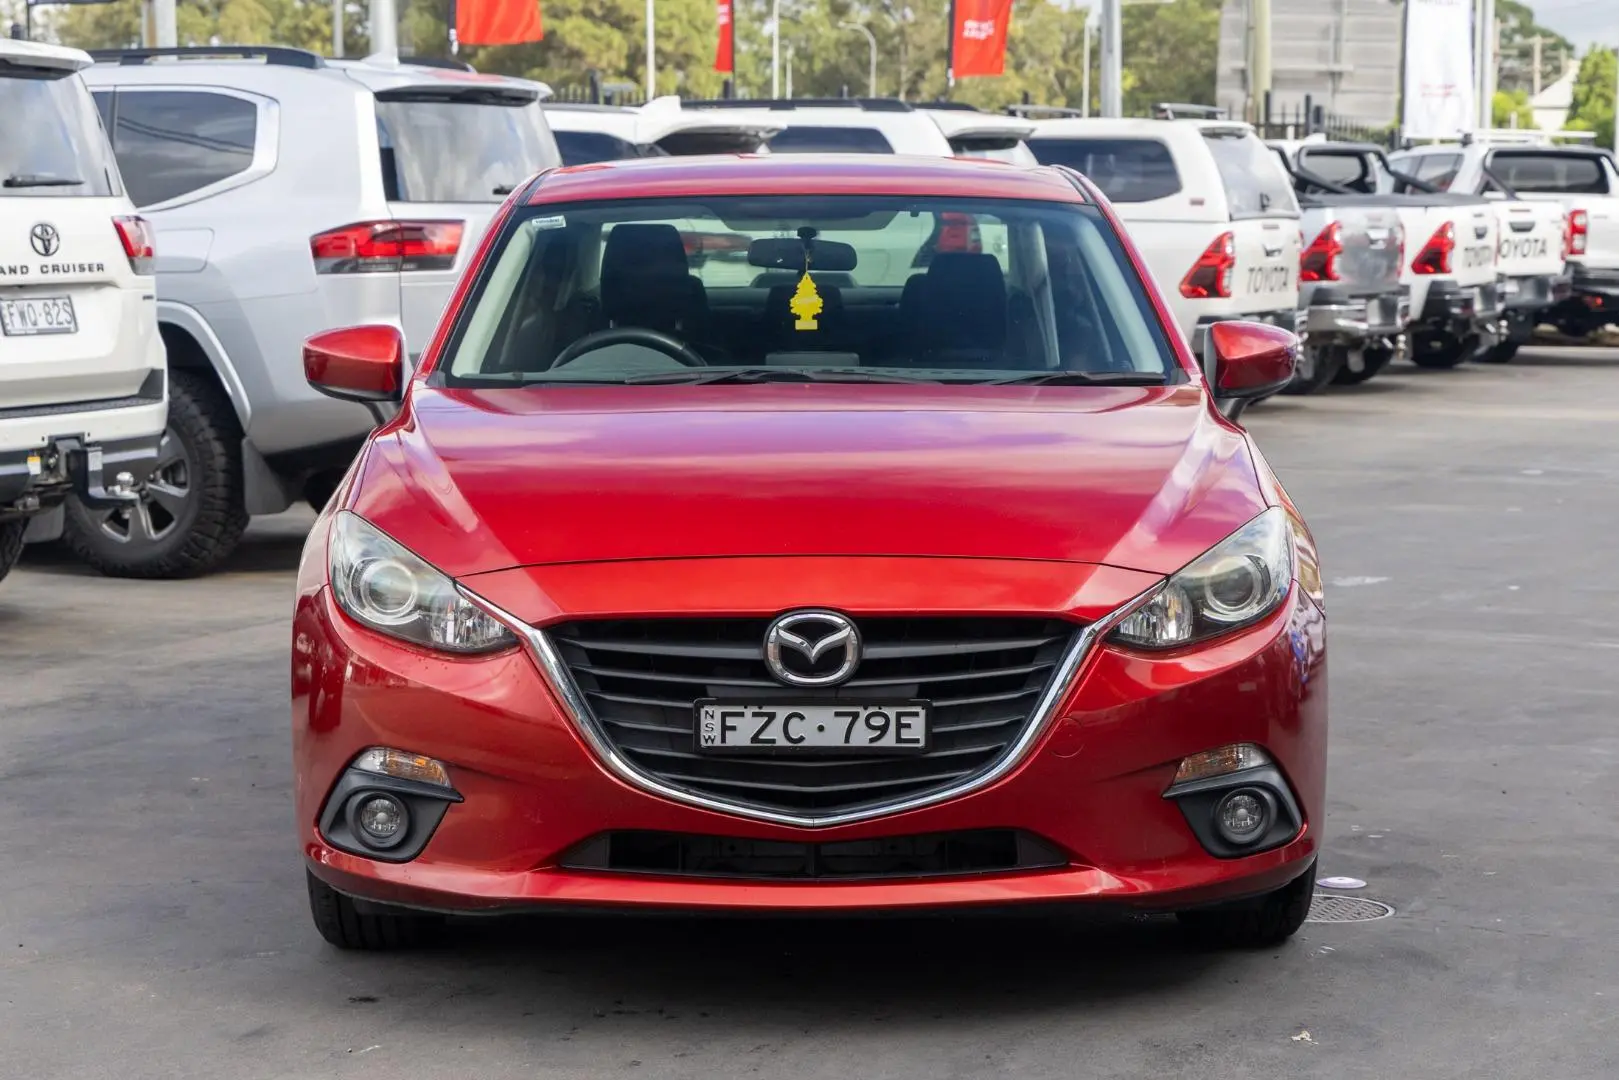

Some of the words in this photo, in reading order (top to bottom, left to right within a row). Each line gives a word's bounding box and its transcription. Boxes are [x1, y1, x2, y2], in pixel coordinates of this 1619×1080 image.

[1500, 238, 1547, 259] OYOTA
[0, 264, 29, 275] AND
[40, 263, 104, 274] CRUISER
